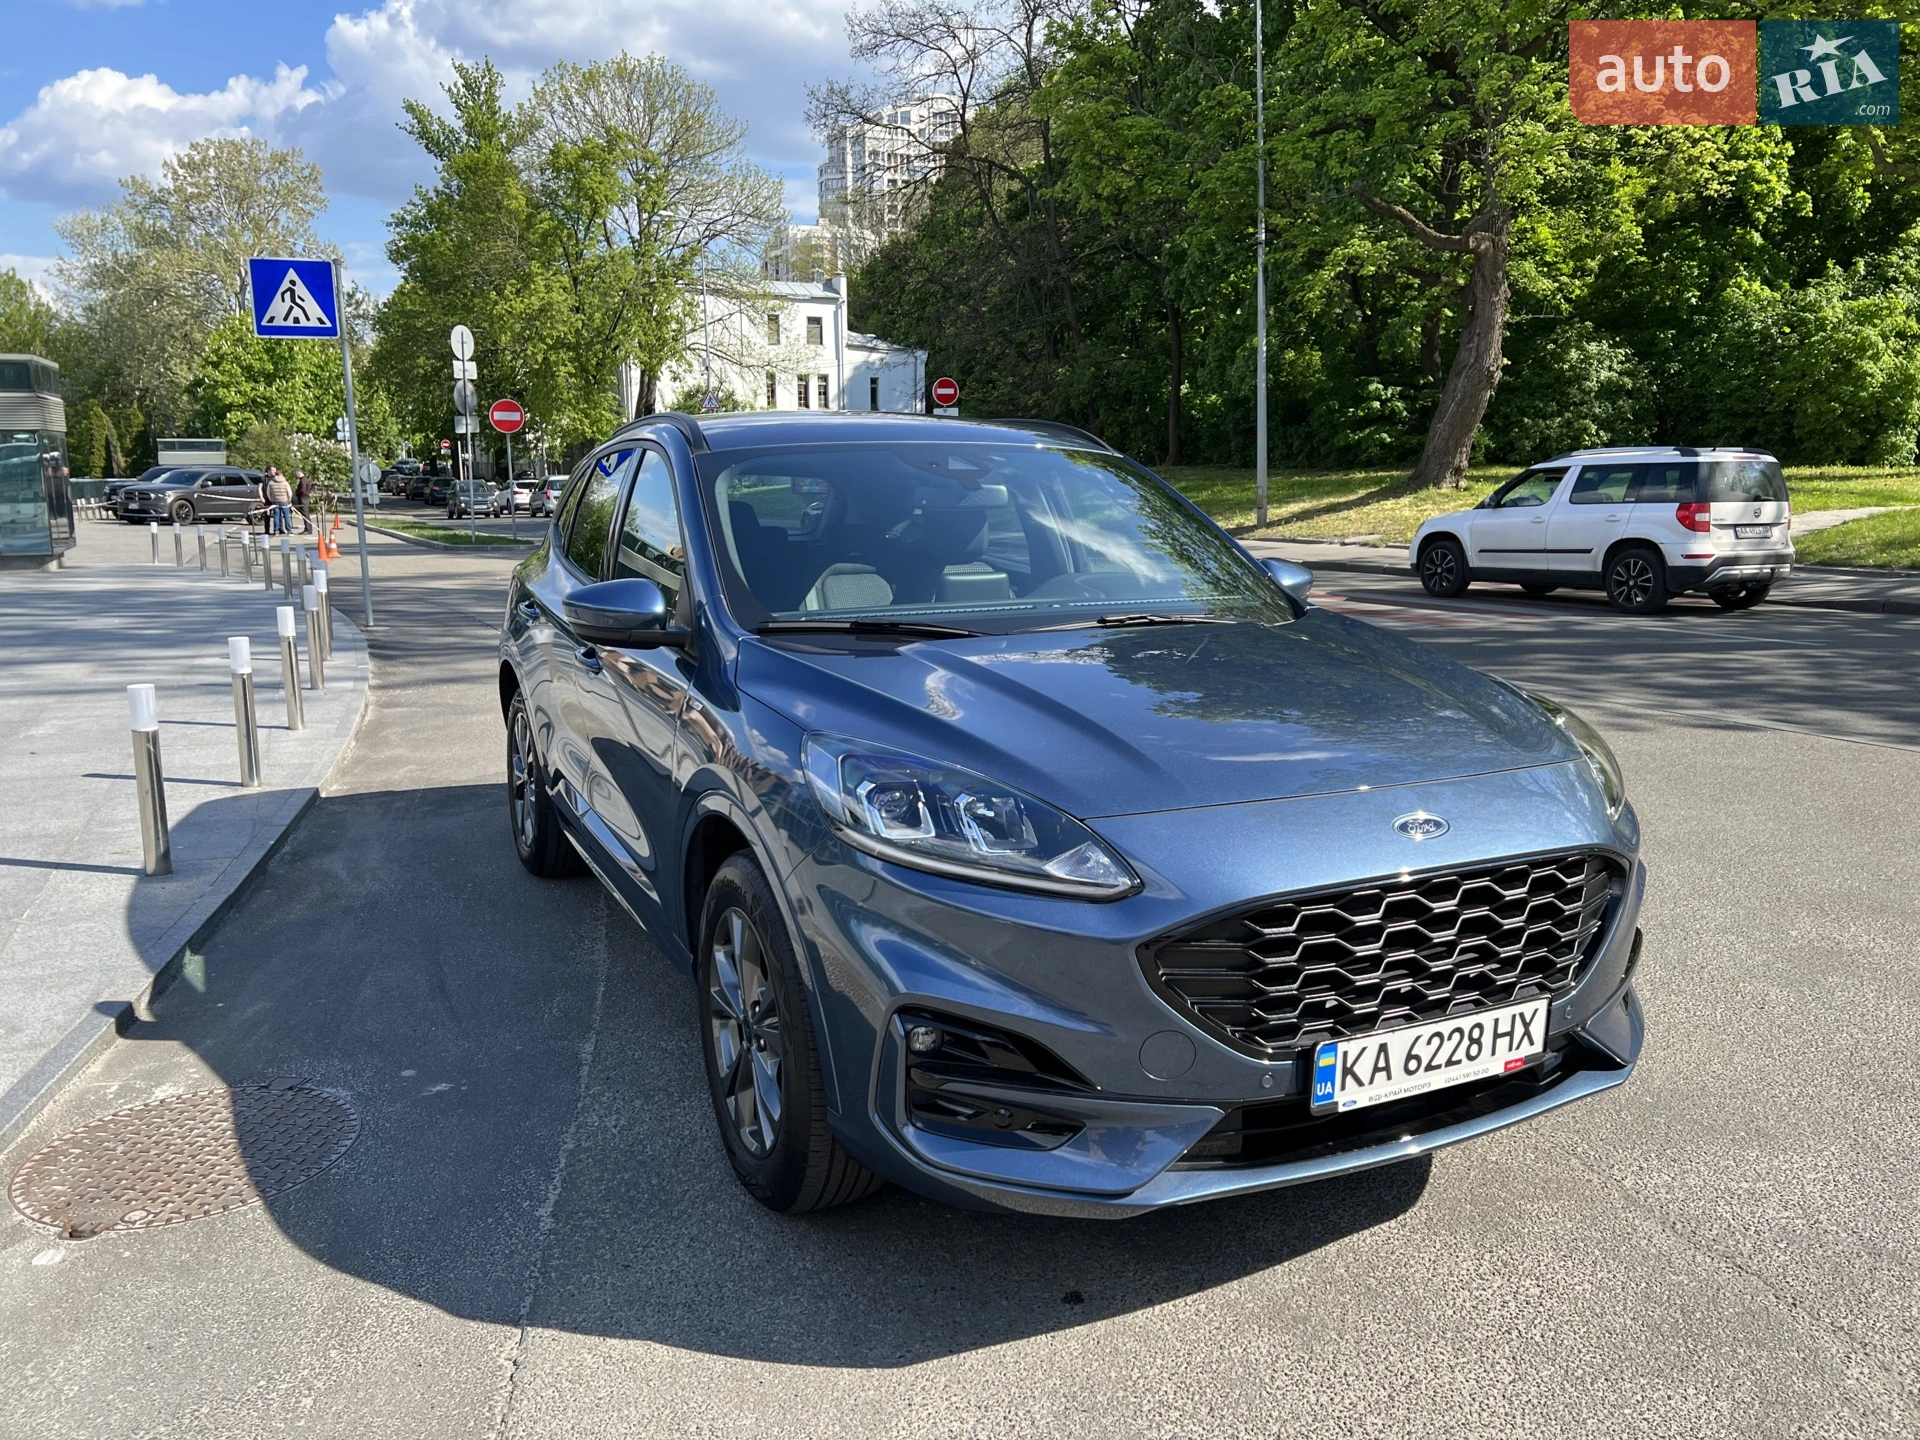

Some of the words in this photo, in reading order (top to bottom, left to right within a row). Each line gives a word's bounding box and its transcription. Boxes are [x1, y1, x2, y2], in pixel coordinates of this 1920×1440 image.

[1407, 819, 1437, 835] Ford
[1340, 1042, 1393, 1092] KA
[1403, 1022, 1485, 1077] 6228
[1490, 1008, 1540, 1057] HX
[1445, 1074, 1462, 1084] (044)
[1462, 1071, 1472, 1080] 591
[1473, 1069, 1480, 1077] 50
[1316, 1082, 1333, 1097] UA
